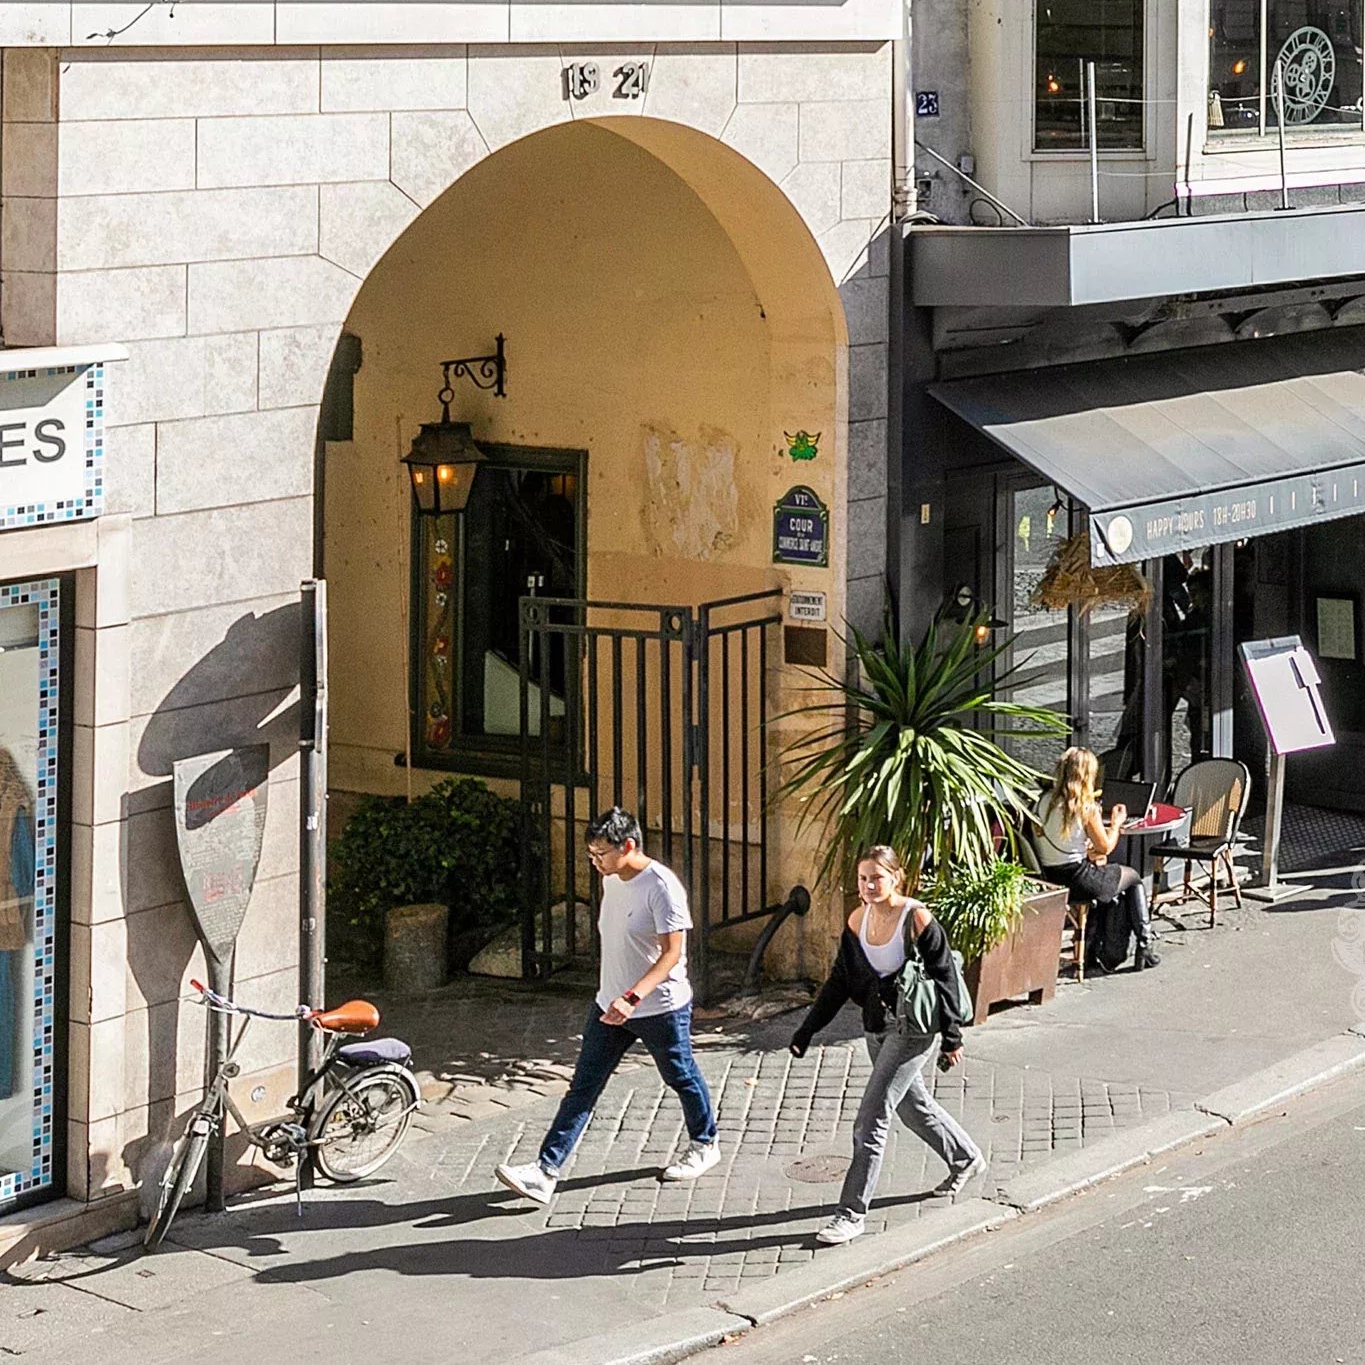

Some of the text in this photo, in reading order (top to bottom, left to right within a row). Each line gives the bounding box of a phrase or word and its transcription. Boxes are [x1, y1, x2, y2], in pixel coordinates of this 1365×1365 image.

[565, 61, 649, 98] 19 21
[918, 94, 937, 114] 23
[0, 418, 66, 468] ES
[790, 518, 813, 533] COUR
[1146, 500, 1257, 540] HAPPY HOURS 18H-20H30
[795, 606, 820, 617] INTERDIT
